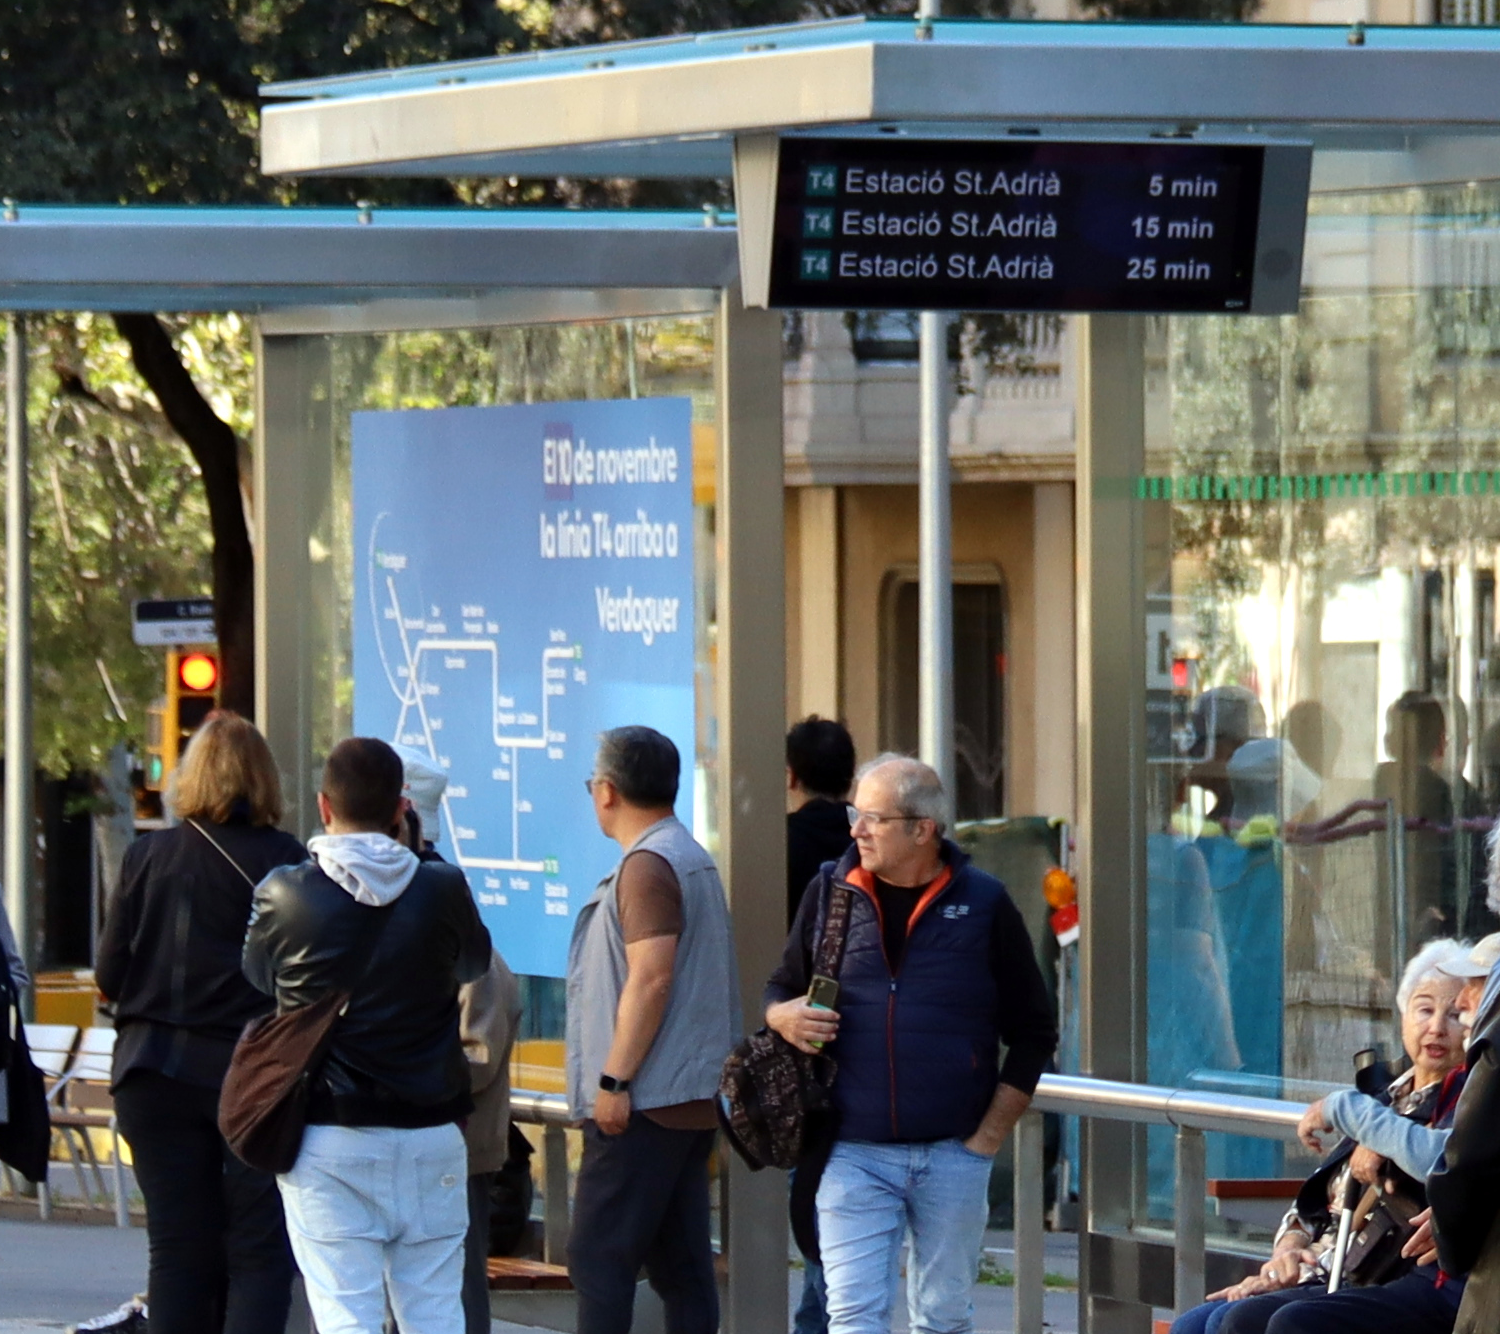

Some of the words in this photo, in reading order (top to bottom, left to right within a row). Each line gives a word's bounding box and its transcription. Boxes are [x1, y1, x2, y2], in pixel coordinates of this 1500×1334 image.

[809, 171, 836, 190] T4
[845, 169, 945, 194] Estació
[953, 170, 1062, 197] St.Adrià
[1148, 174, 1164, 197] 5
[1170, 175, 1219, 197] min
[805, 214, 832, 232] T4
[842, 211, 942, 236] Estació
[950, 212, 1058, 238] St.Adrià
[1130, 217, 1160, 238] 15
[1167, 217, 1214, 238] min
[802, 256, 829, 275] T4
[839, 252, 938, 278] Estació
[946, 253, 1055, 280] St.Adrià
[1126, 258, 1157, 280] 25
[1164, 259, 1212, 280] min
[543, 437, 557, 485] El
[557, 437, 573, 486] 10
[573, 437, 595, 485] de
[596, 436, 678, 485] novembre
[540, 512, 556, 558] la
[557, 509, 591, 558] línia
[591, 511, 612, 558] T4
[614, 507, 665, 558] arriba
[665, 522, 679, 558] a
[594, 585, 680, 646] Verdaguer
